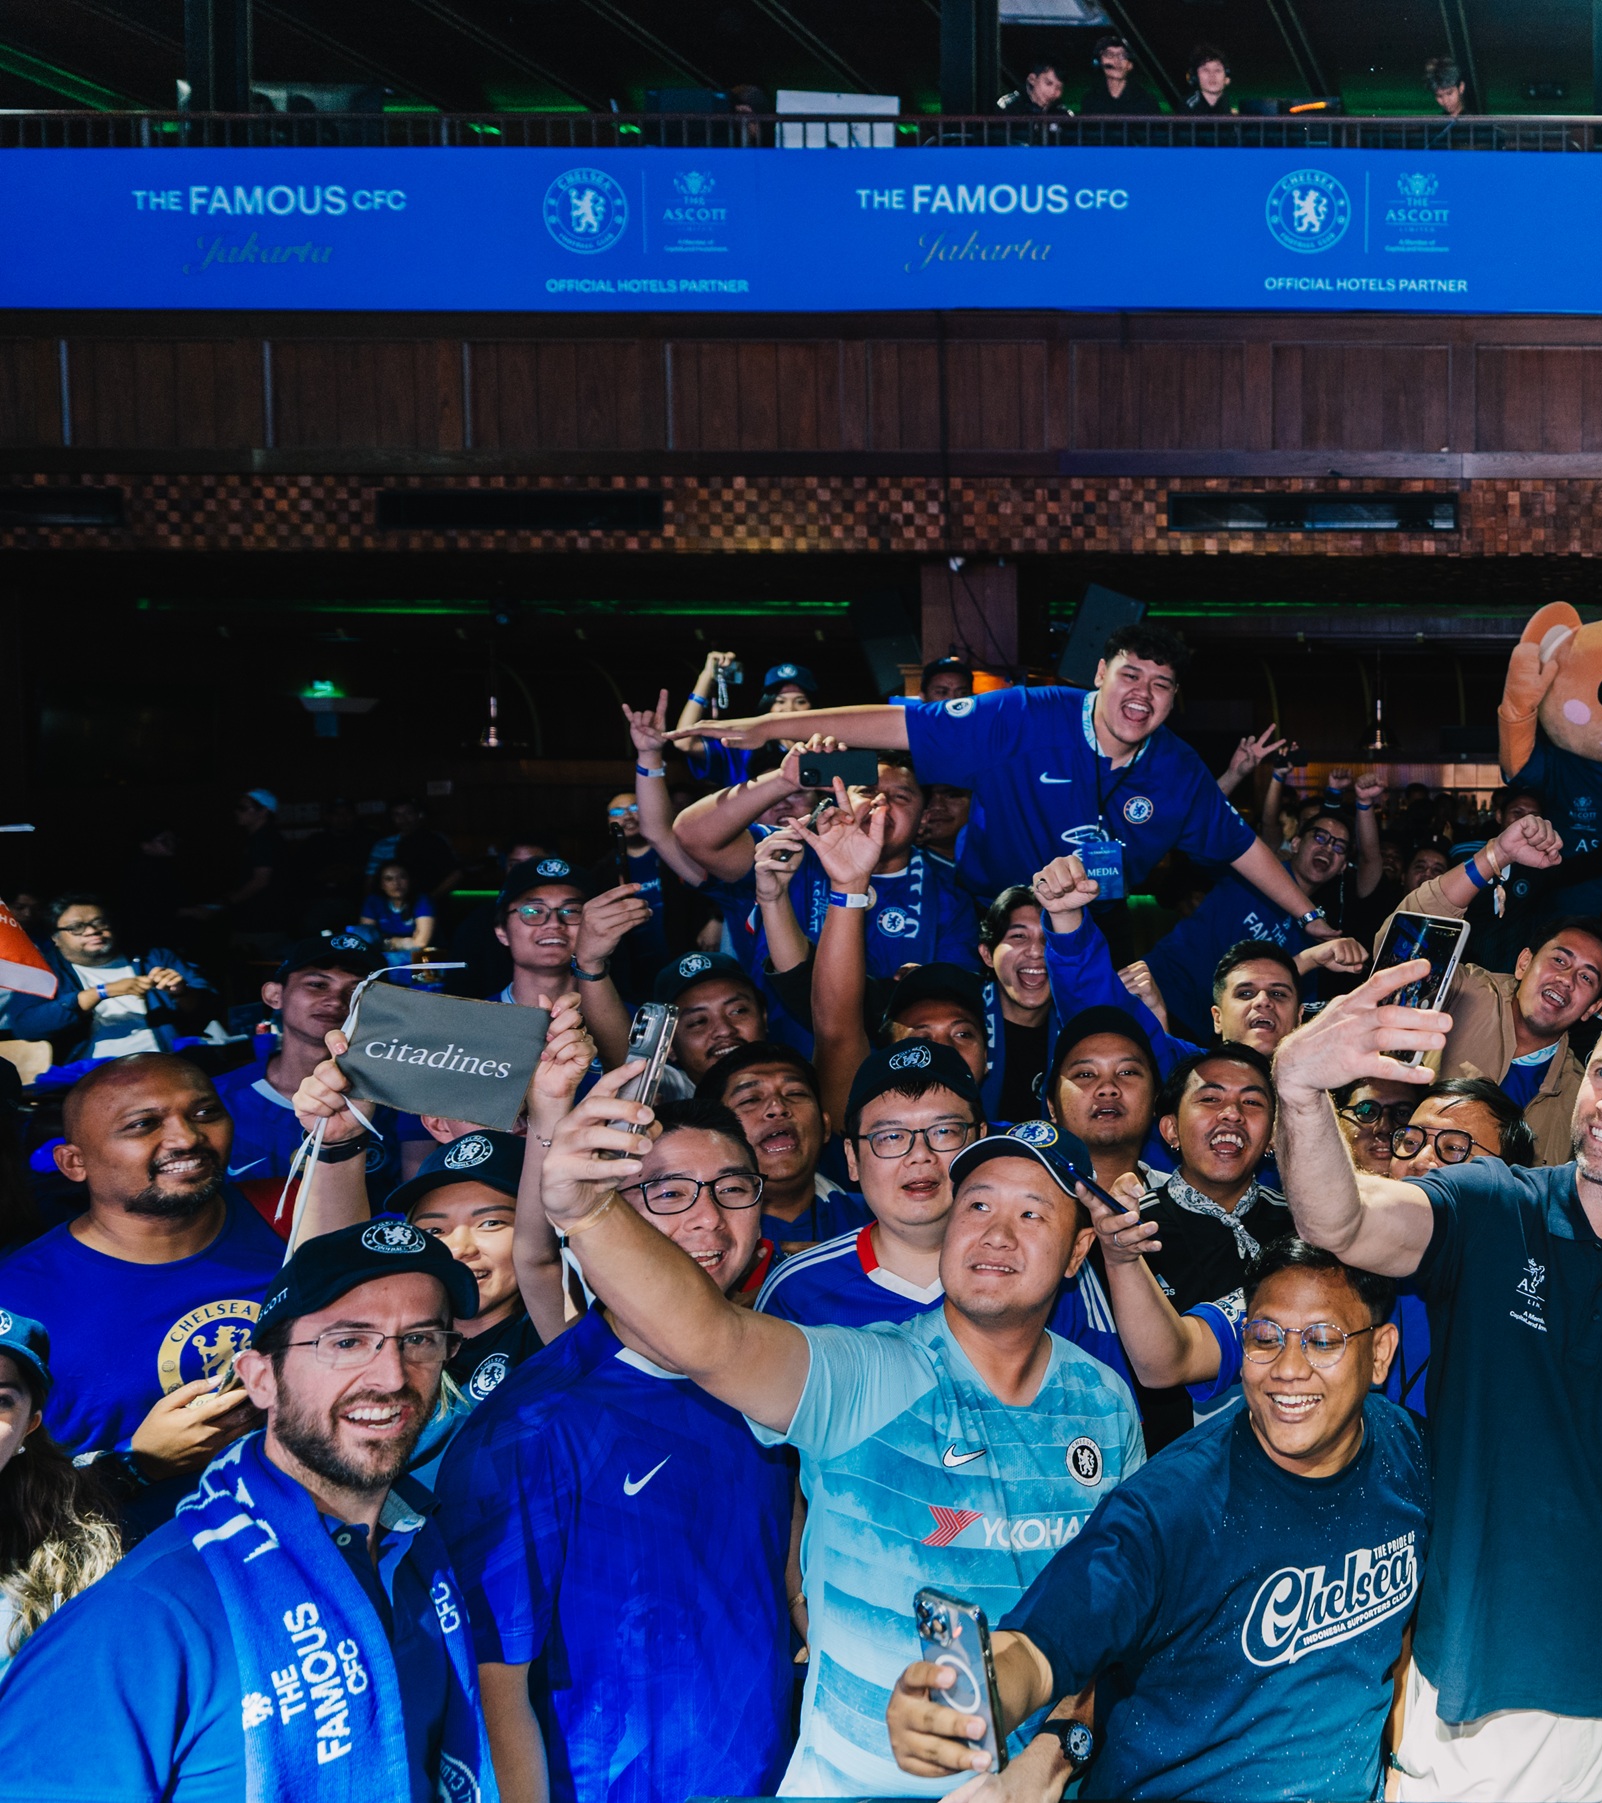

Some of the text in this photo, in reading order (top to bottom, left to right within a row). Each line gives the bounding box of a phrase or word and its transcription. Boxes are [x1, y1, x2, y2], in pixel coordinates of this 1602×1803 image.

[1282, 172, 1334, 191] CHELSEA
[133, 186, 406, 215] THE FAMOUS CFC
[857, 185, 1128, 214] THE FAMOUS CFC
[1385, 209, 1449, 222] ASCOTT
[1405, 197, 1428, 207] THE
[183, 231, 333, 275] Jakarta
[904, 229, 1052, 272] Jakarta
[546, 279, 749, 293] OFFICIAL HOTELS PARTNER
[1264, 277, 1468, 293] OFFICIAL HOTELS PARTNER
[1087, 867, 1119, 877] MEDIA
[1243, 911, 1273, 942] FAM
[1272, 922, 1288, 947] THE
[365, 1038, 511, 1078] citadines
[257, 1287, 289, 1321] SCOTT
[170, 1303, 251, 1343] CHELSEA
[982, 1515, 1090, 1549] YOKOHA
[1373, 1545, 1387, 1559] THE
[1387, 1535, 1408, 1556] PRIDE
[433, 1581, 461, 1634] CFC
[1244, 1548, 1415, 1664] Chelsea
[1303, 1589, 1408, 1646] INDONESIA SUPPORTERS CLUB
[284, 1602, 352, 1765] FAMOUS
[337, 1638, 368, 1695] CFC
[272, 1664, 307, 1725] THE
